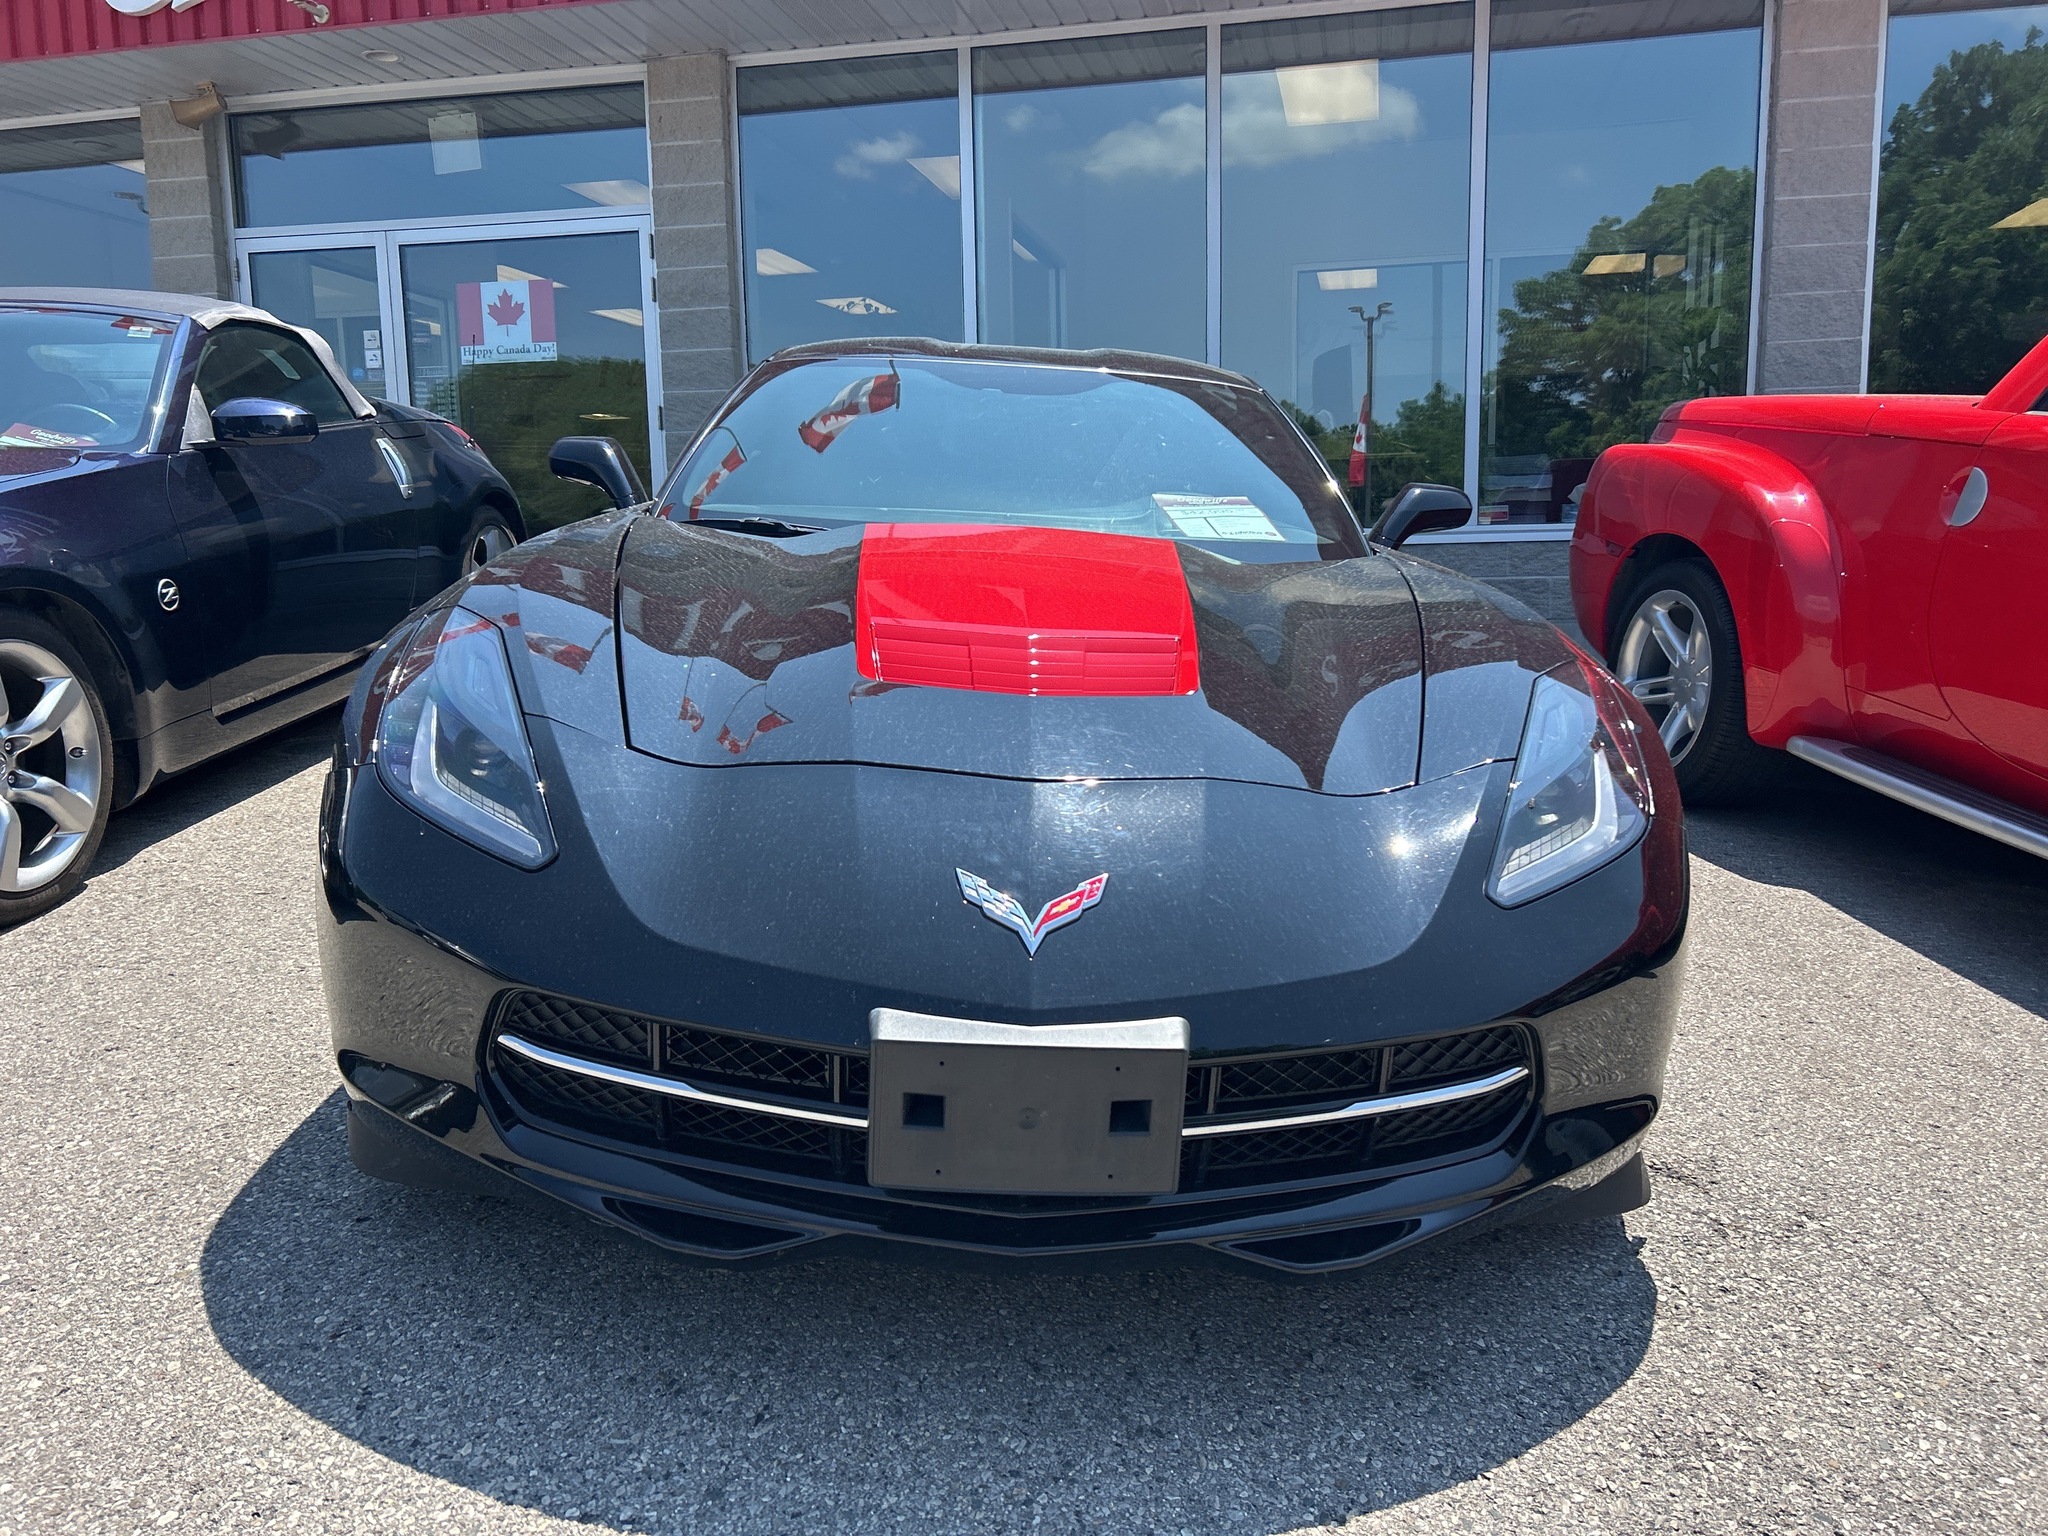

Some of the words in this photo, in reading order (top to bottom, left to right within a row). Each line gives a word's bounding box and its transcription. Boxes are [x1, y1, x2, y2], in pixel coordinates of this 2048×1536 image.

[463, 346, 494, 359] Happy
[496, 343, 531, 355] Canada
[533, 343, 556, 356] Day!
